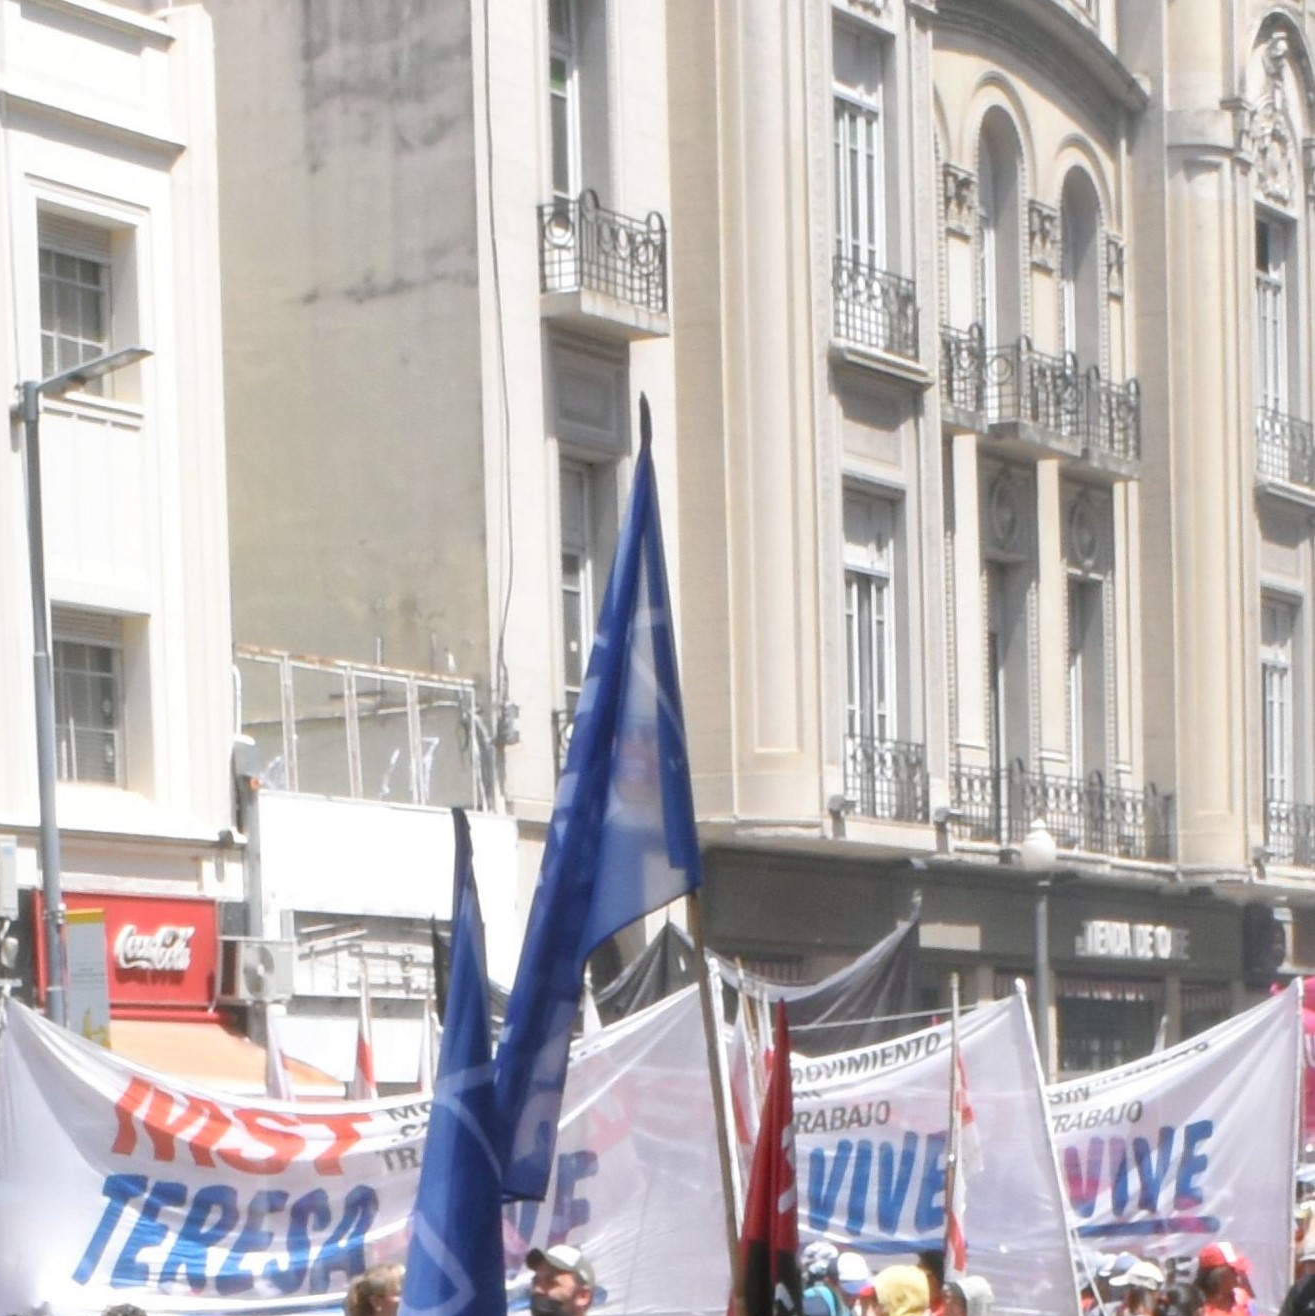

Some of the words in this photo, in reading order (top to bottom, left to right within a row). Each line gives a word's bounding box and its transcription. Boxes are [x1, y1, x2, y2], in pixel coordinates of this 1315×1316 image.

[112, 1076, 373, 1176] MST
[1052, 1101, 1143, 1134] TRABAJO
[807, 1131, 948, 1236] VIVE
[1064, 1119, 1214, 1218] VIVE
[72, 1173, 380, 1297] TERESA
